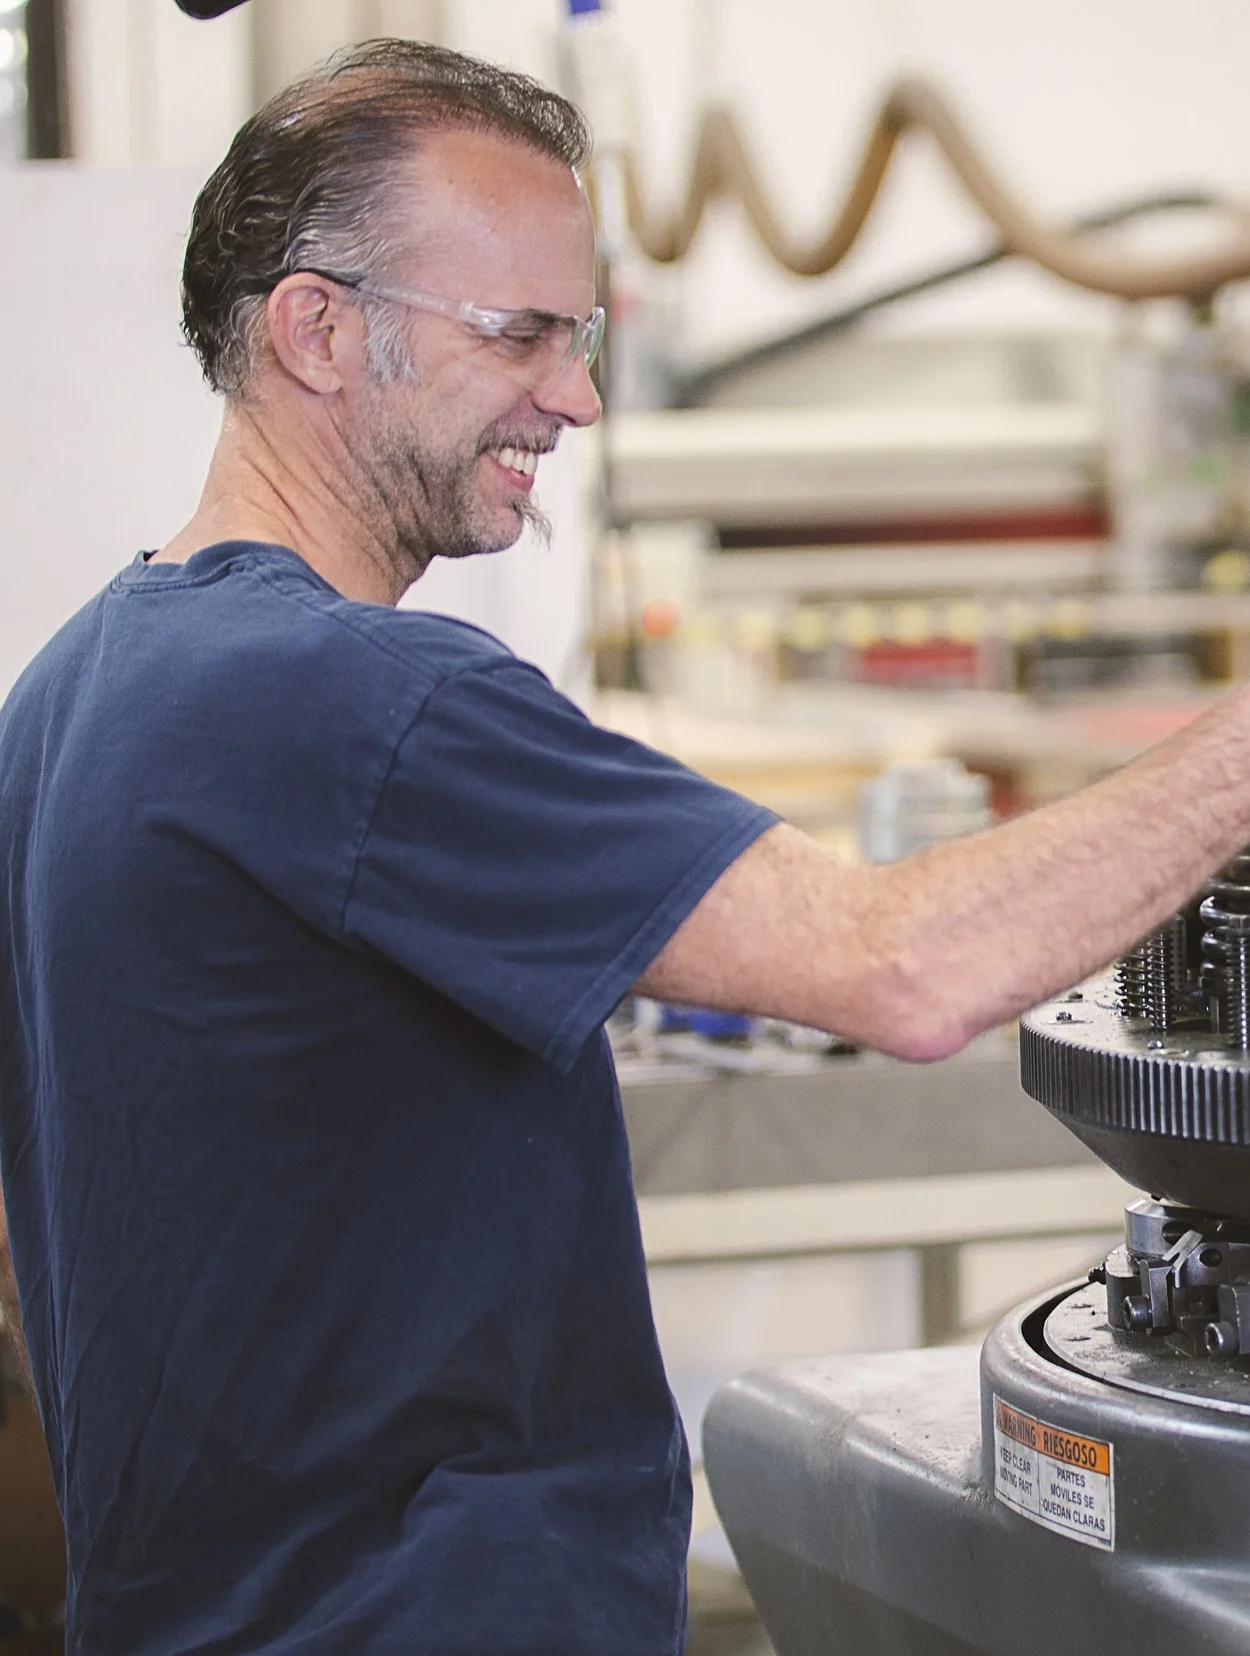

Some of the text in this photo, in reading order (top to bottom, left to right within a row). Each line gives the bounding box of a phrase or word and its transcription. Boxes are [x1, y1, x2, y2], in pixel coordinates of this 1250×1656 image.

[1001, 1410, 1097, 1468] WARNING RIESGOSO
[1013, 1454, 1031, 1475] CLEAR
[1019, 1477, 1033, 1495] PART
[1056, 1467, 1086, 1488] PARTES
[1083, 1494, 1095, 1510] SE
[1042, 1498, 1106, 1531] QUEDAN CLARAS
